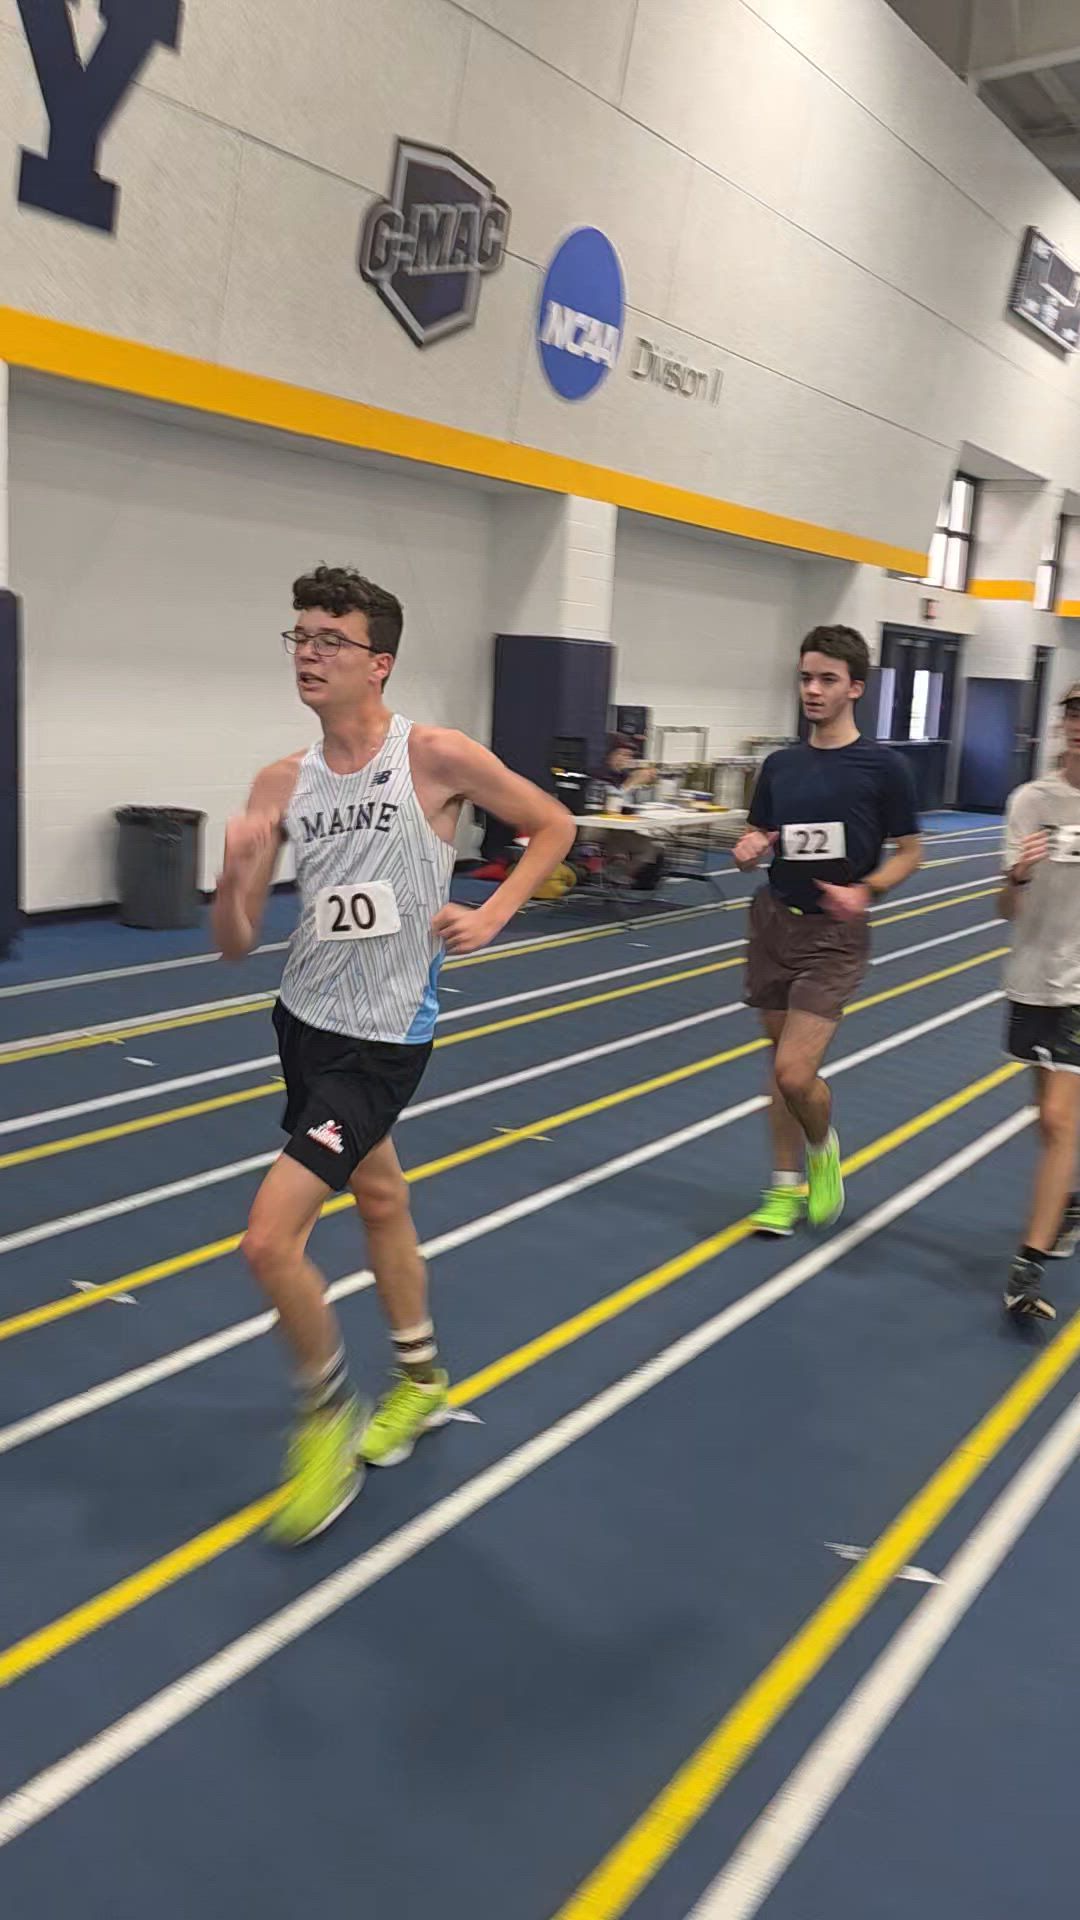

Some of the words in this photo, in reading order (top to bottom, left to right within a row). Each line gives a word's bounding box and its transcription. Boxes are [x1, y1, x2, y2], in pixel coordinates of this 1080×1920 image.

[17, 0, 184, 236] Y
[361, 198, 511, 277] G-MAC
[540, 300, 620, 368] NCAA
[301, 802, 399, 843] MAINE
[793, 829, 831, 854] 22
[328, 892, 377, 933] 20
